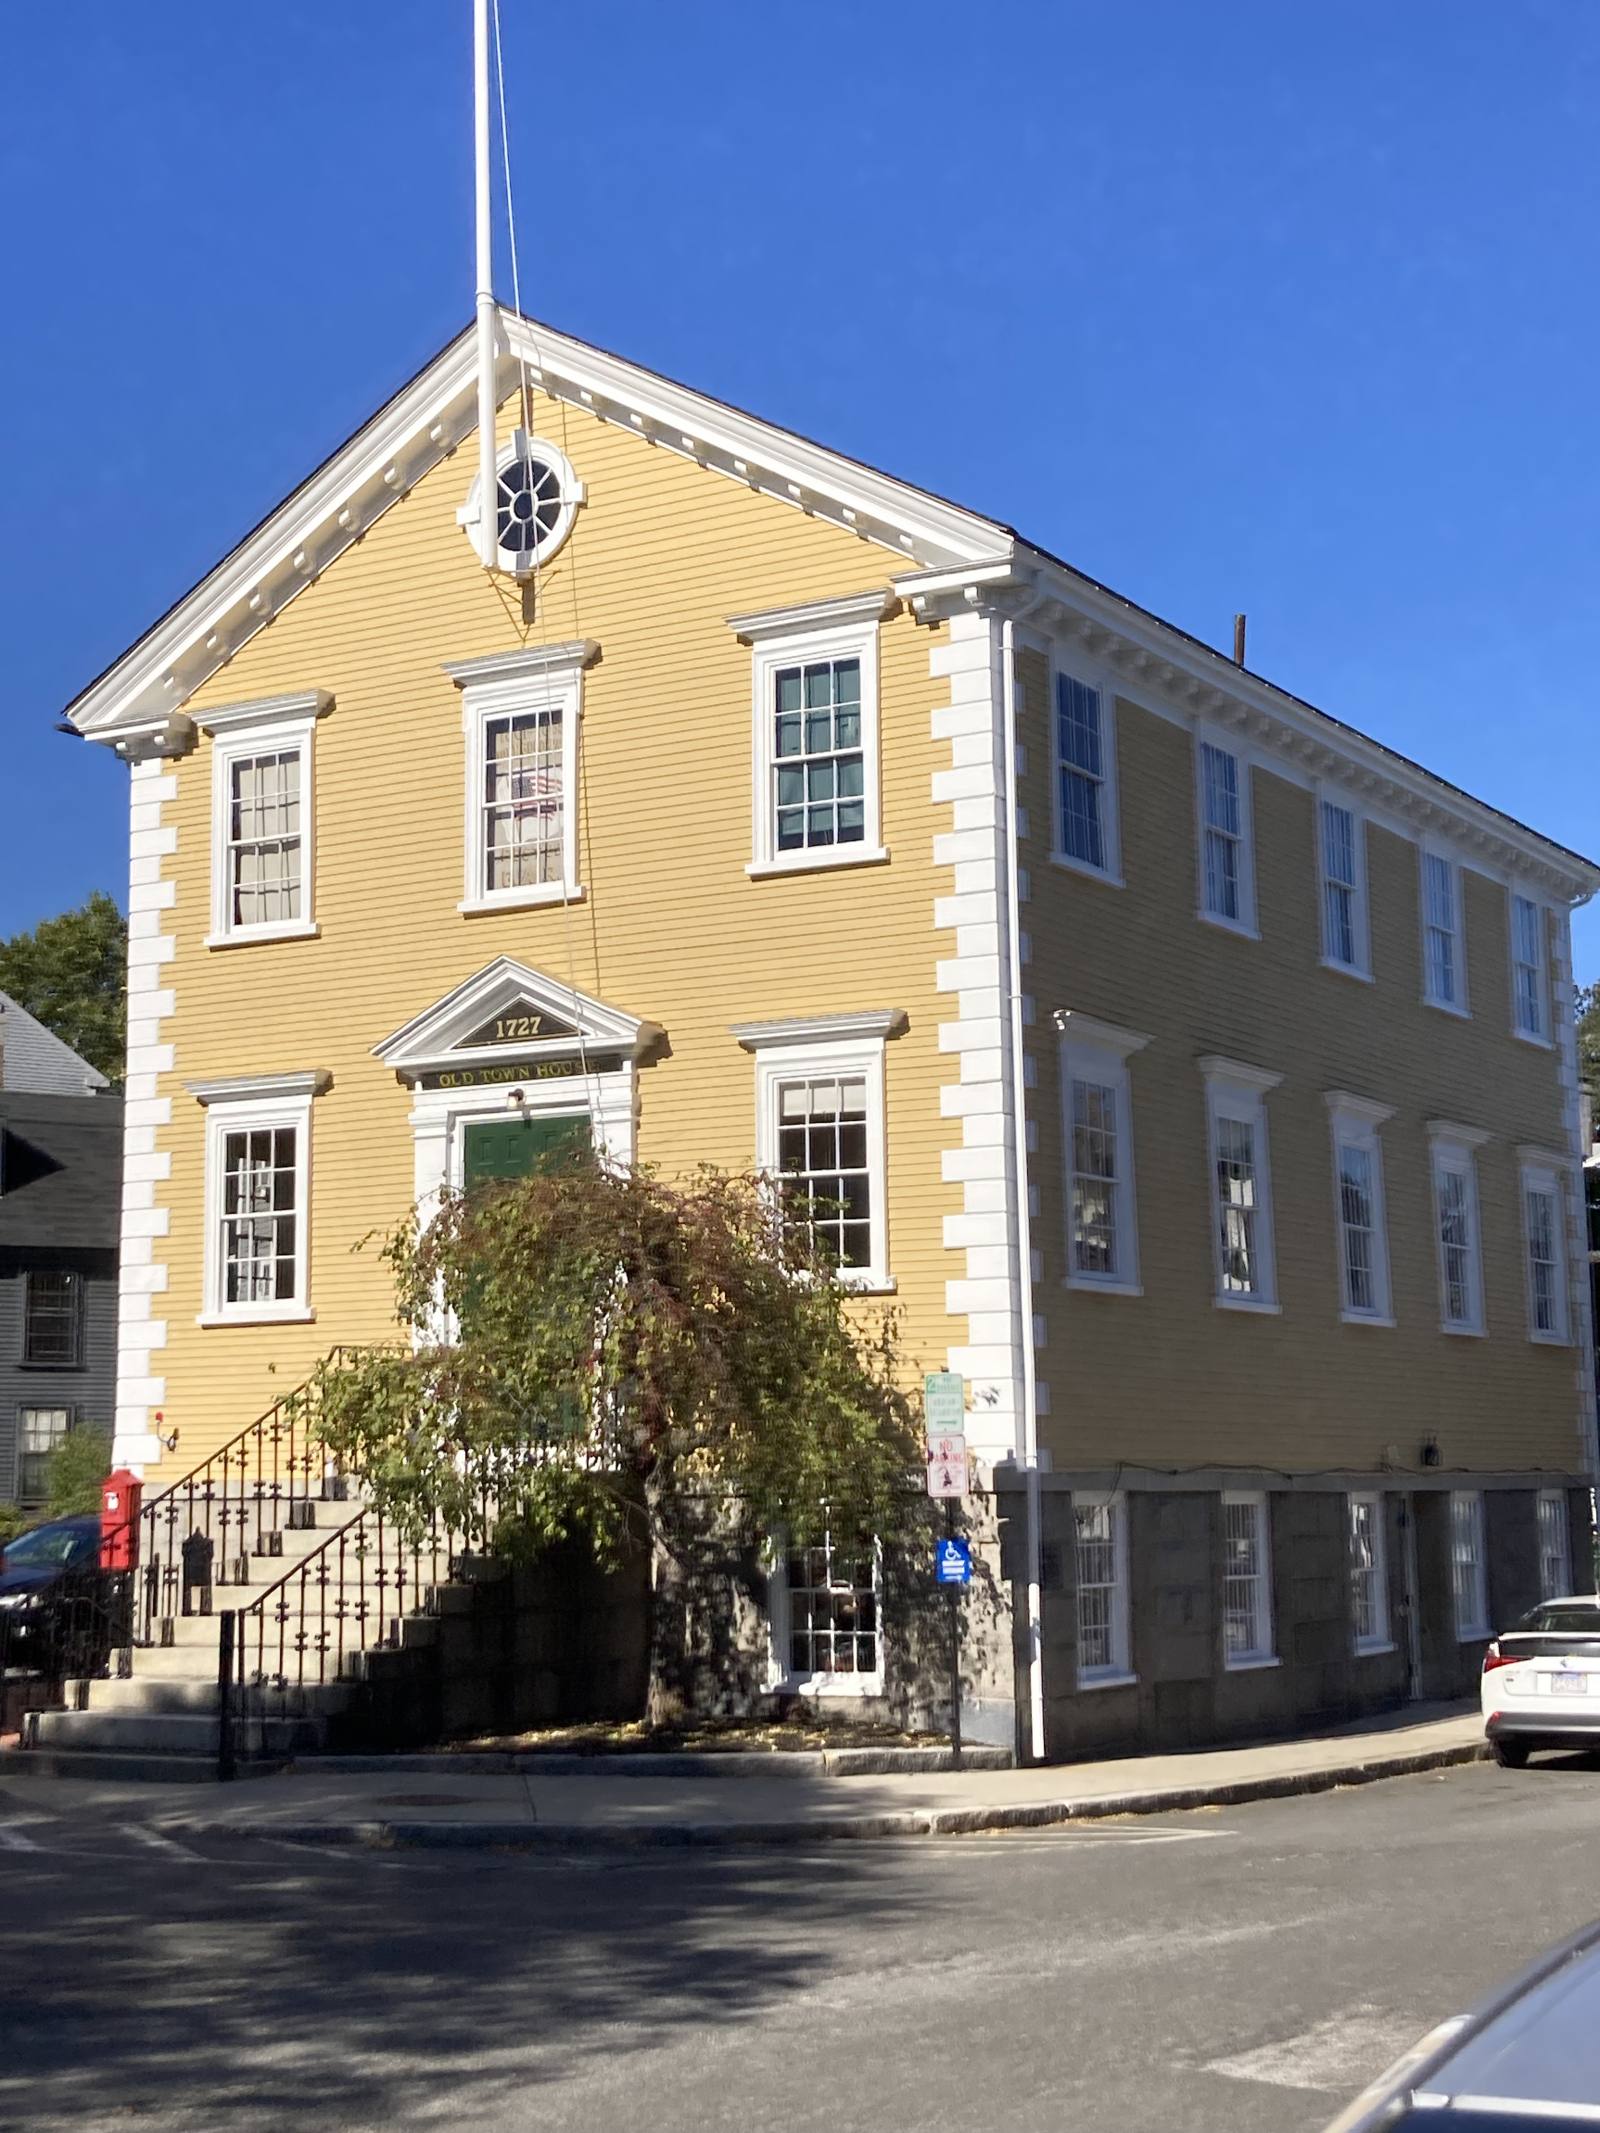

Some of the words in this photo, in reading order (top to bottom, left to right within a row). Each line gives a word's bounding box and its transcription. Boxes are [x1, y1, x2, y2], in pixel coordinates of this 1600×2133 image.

[496, 1016, 541, 1038] 1727
[439, 1072, 473, 1087] OLD
[480, 1066, 530, 1083] TOWN
[535, 1059, 601, 1077] HOUSE
[928, 1376, 936, 1391] 2
[939, 1441, 953, 1452] NO
[930, 1453, 964, 1463] ARKING
